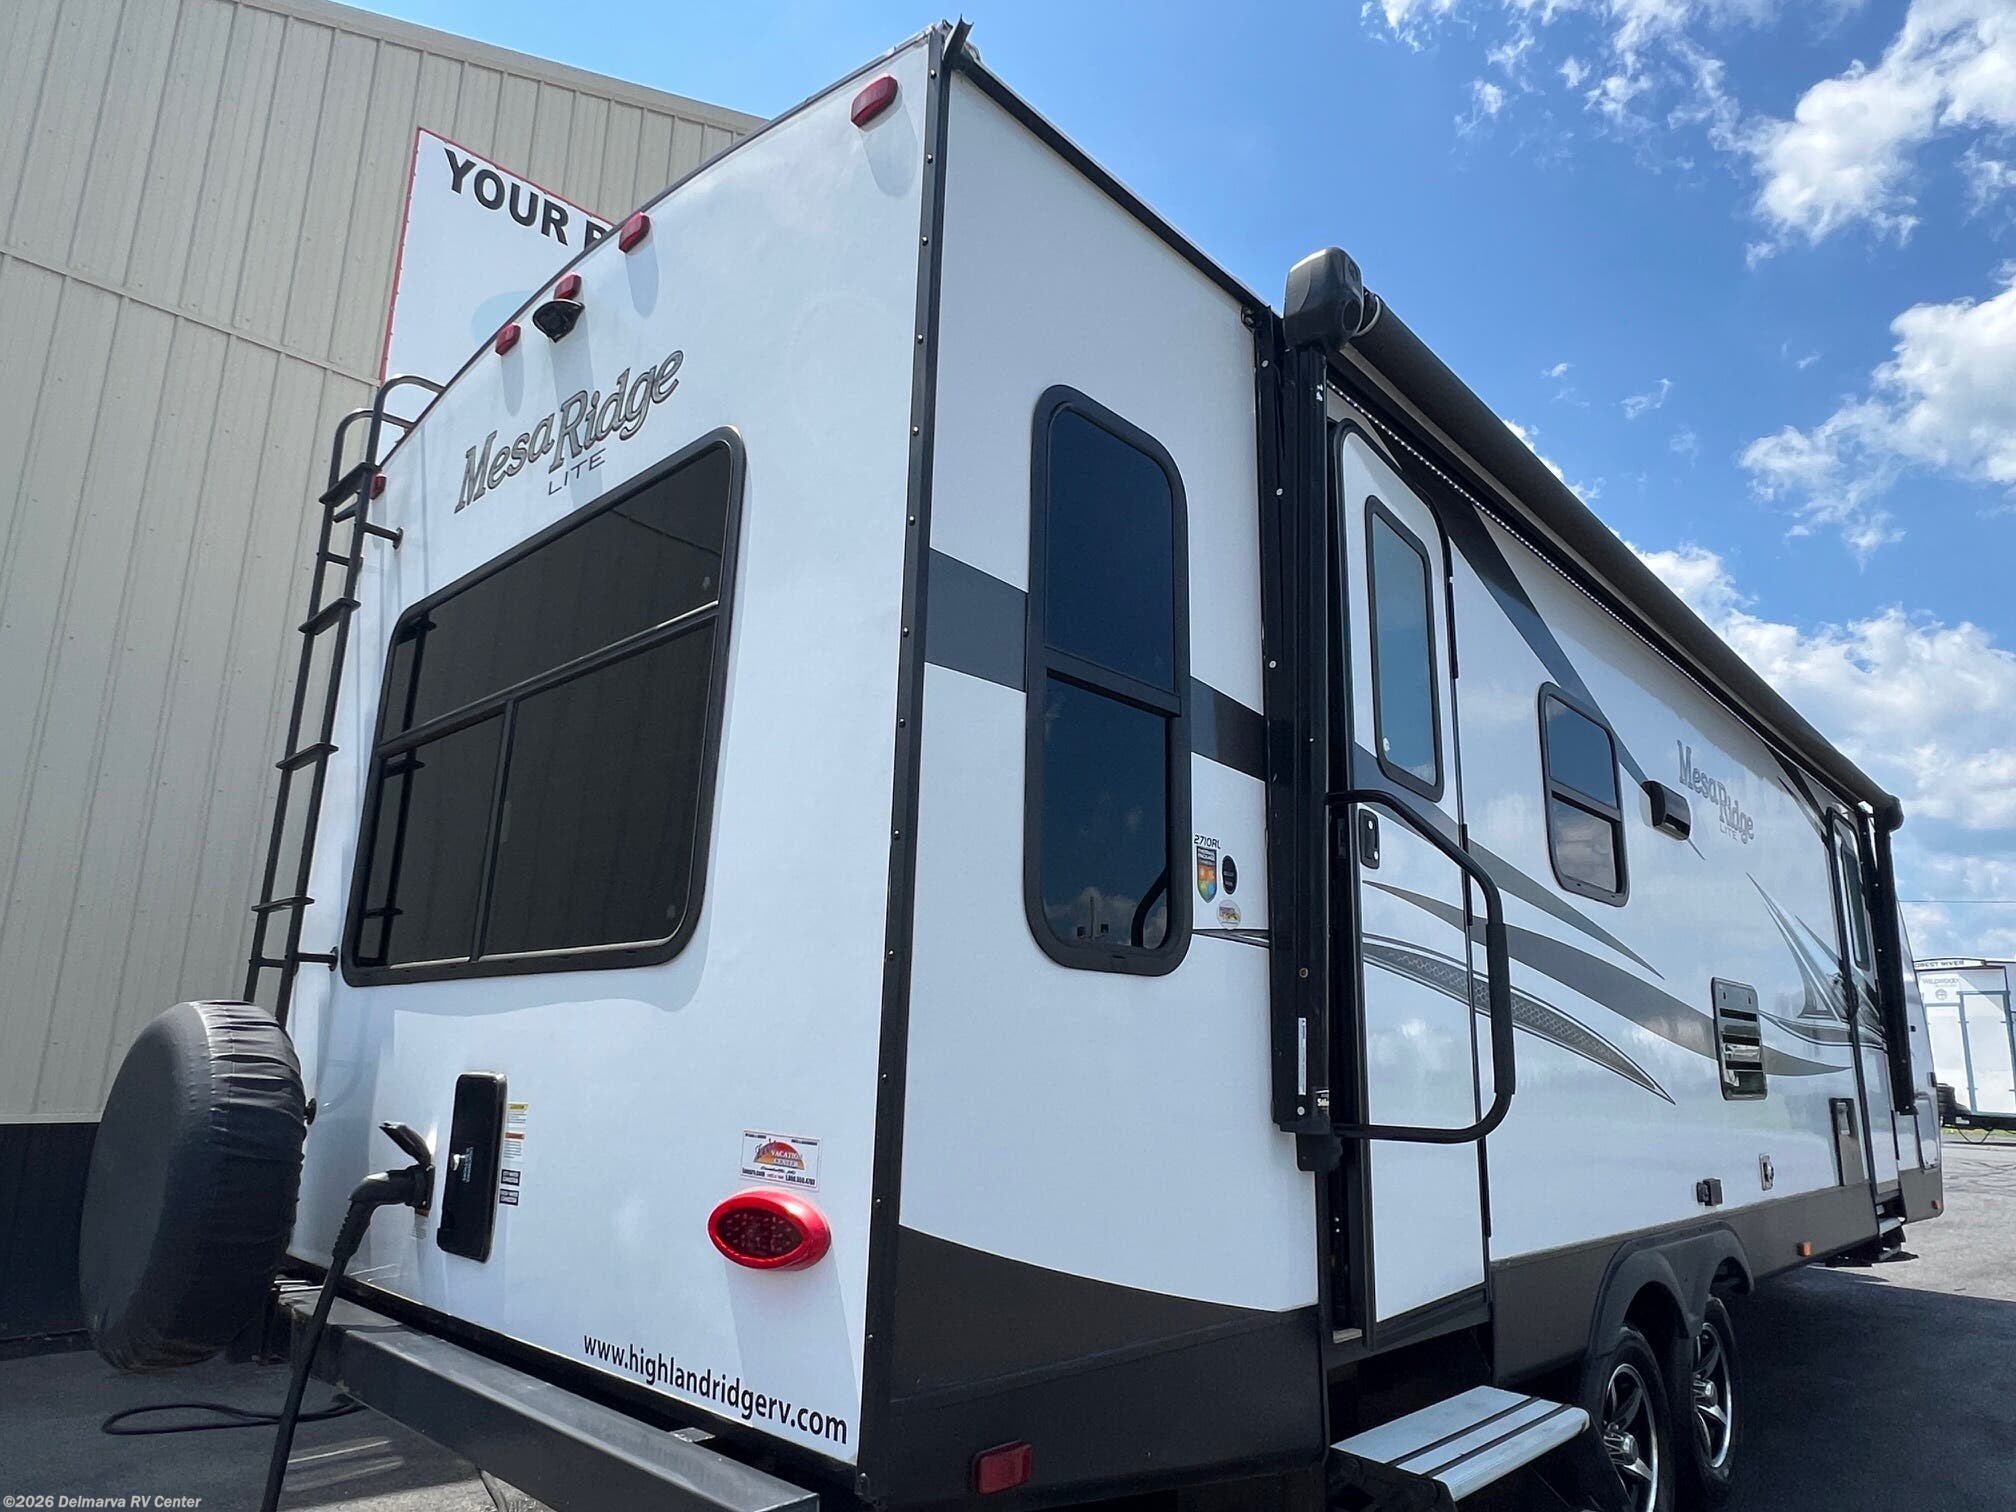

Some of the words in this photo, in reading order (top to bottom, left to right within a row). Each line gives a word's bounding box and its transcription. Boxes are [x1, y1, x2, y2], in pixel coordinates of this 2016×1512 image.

[444, 147, 569, 247] YOUR
[548, 448, 607, 496] LITE
[1914, 961, 1939, 969] OREST
[583, 1334, 848, 1445] www.highlandridgerv.com
